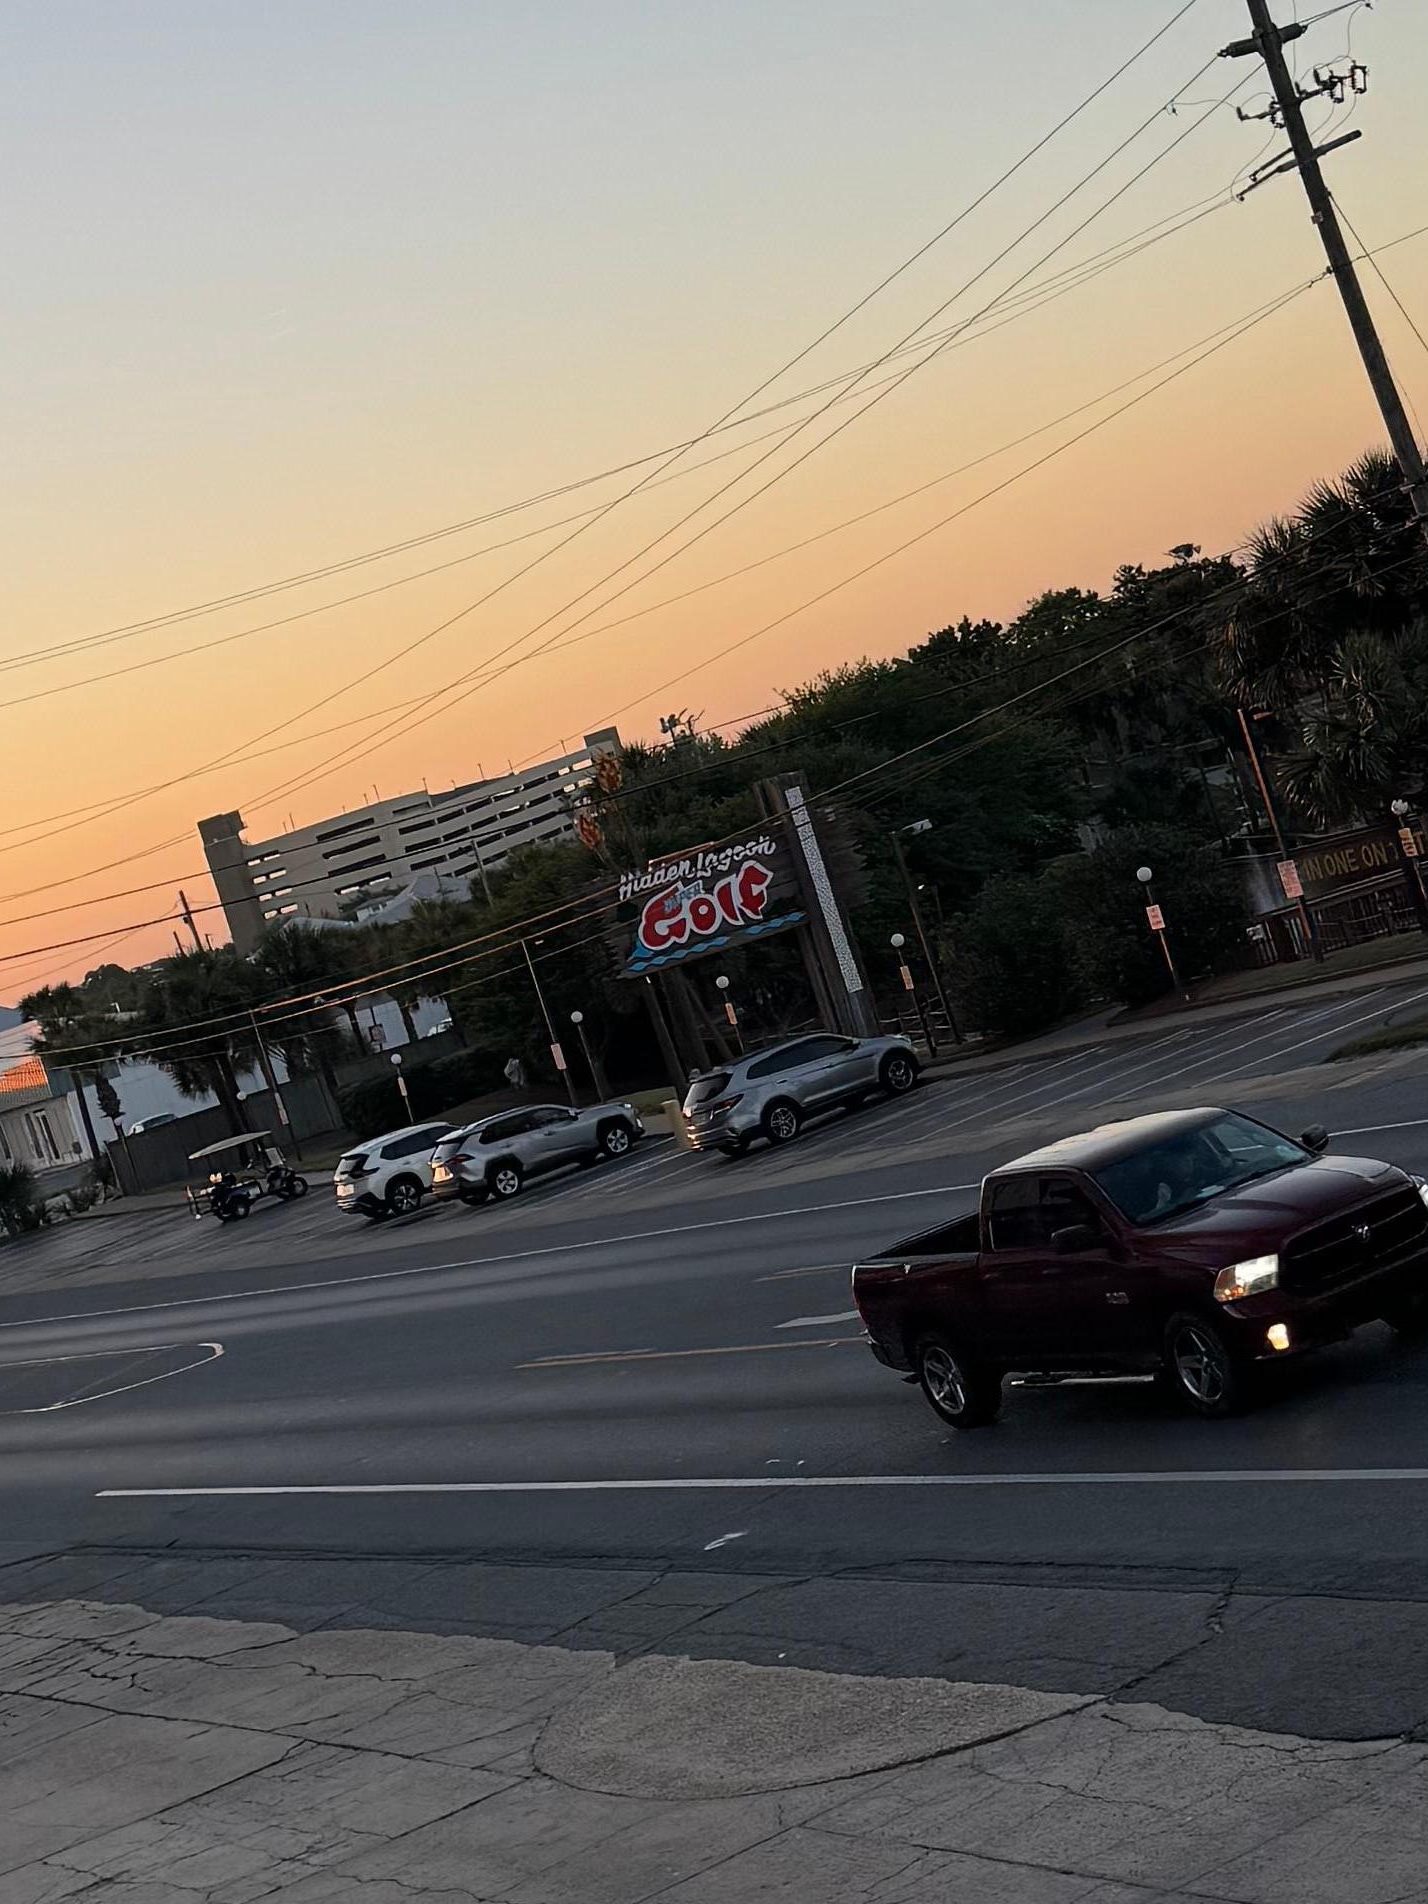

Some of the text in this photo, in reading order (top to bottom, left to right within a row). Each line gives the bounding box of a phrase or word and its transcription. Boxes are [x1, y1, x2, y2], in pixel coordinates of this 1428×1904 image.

[618, 836, 776, 901] Hidden Lagoon
[1324, 848, 1360, 877] ONE
